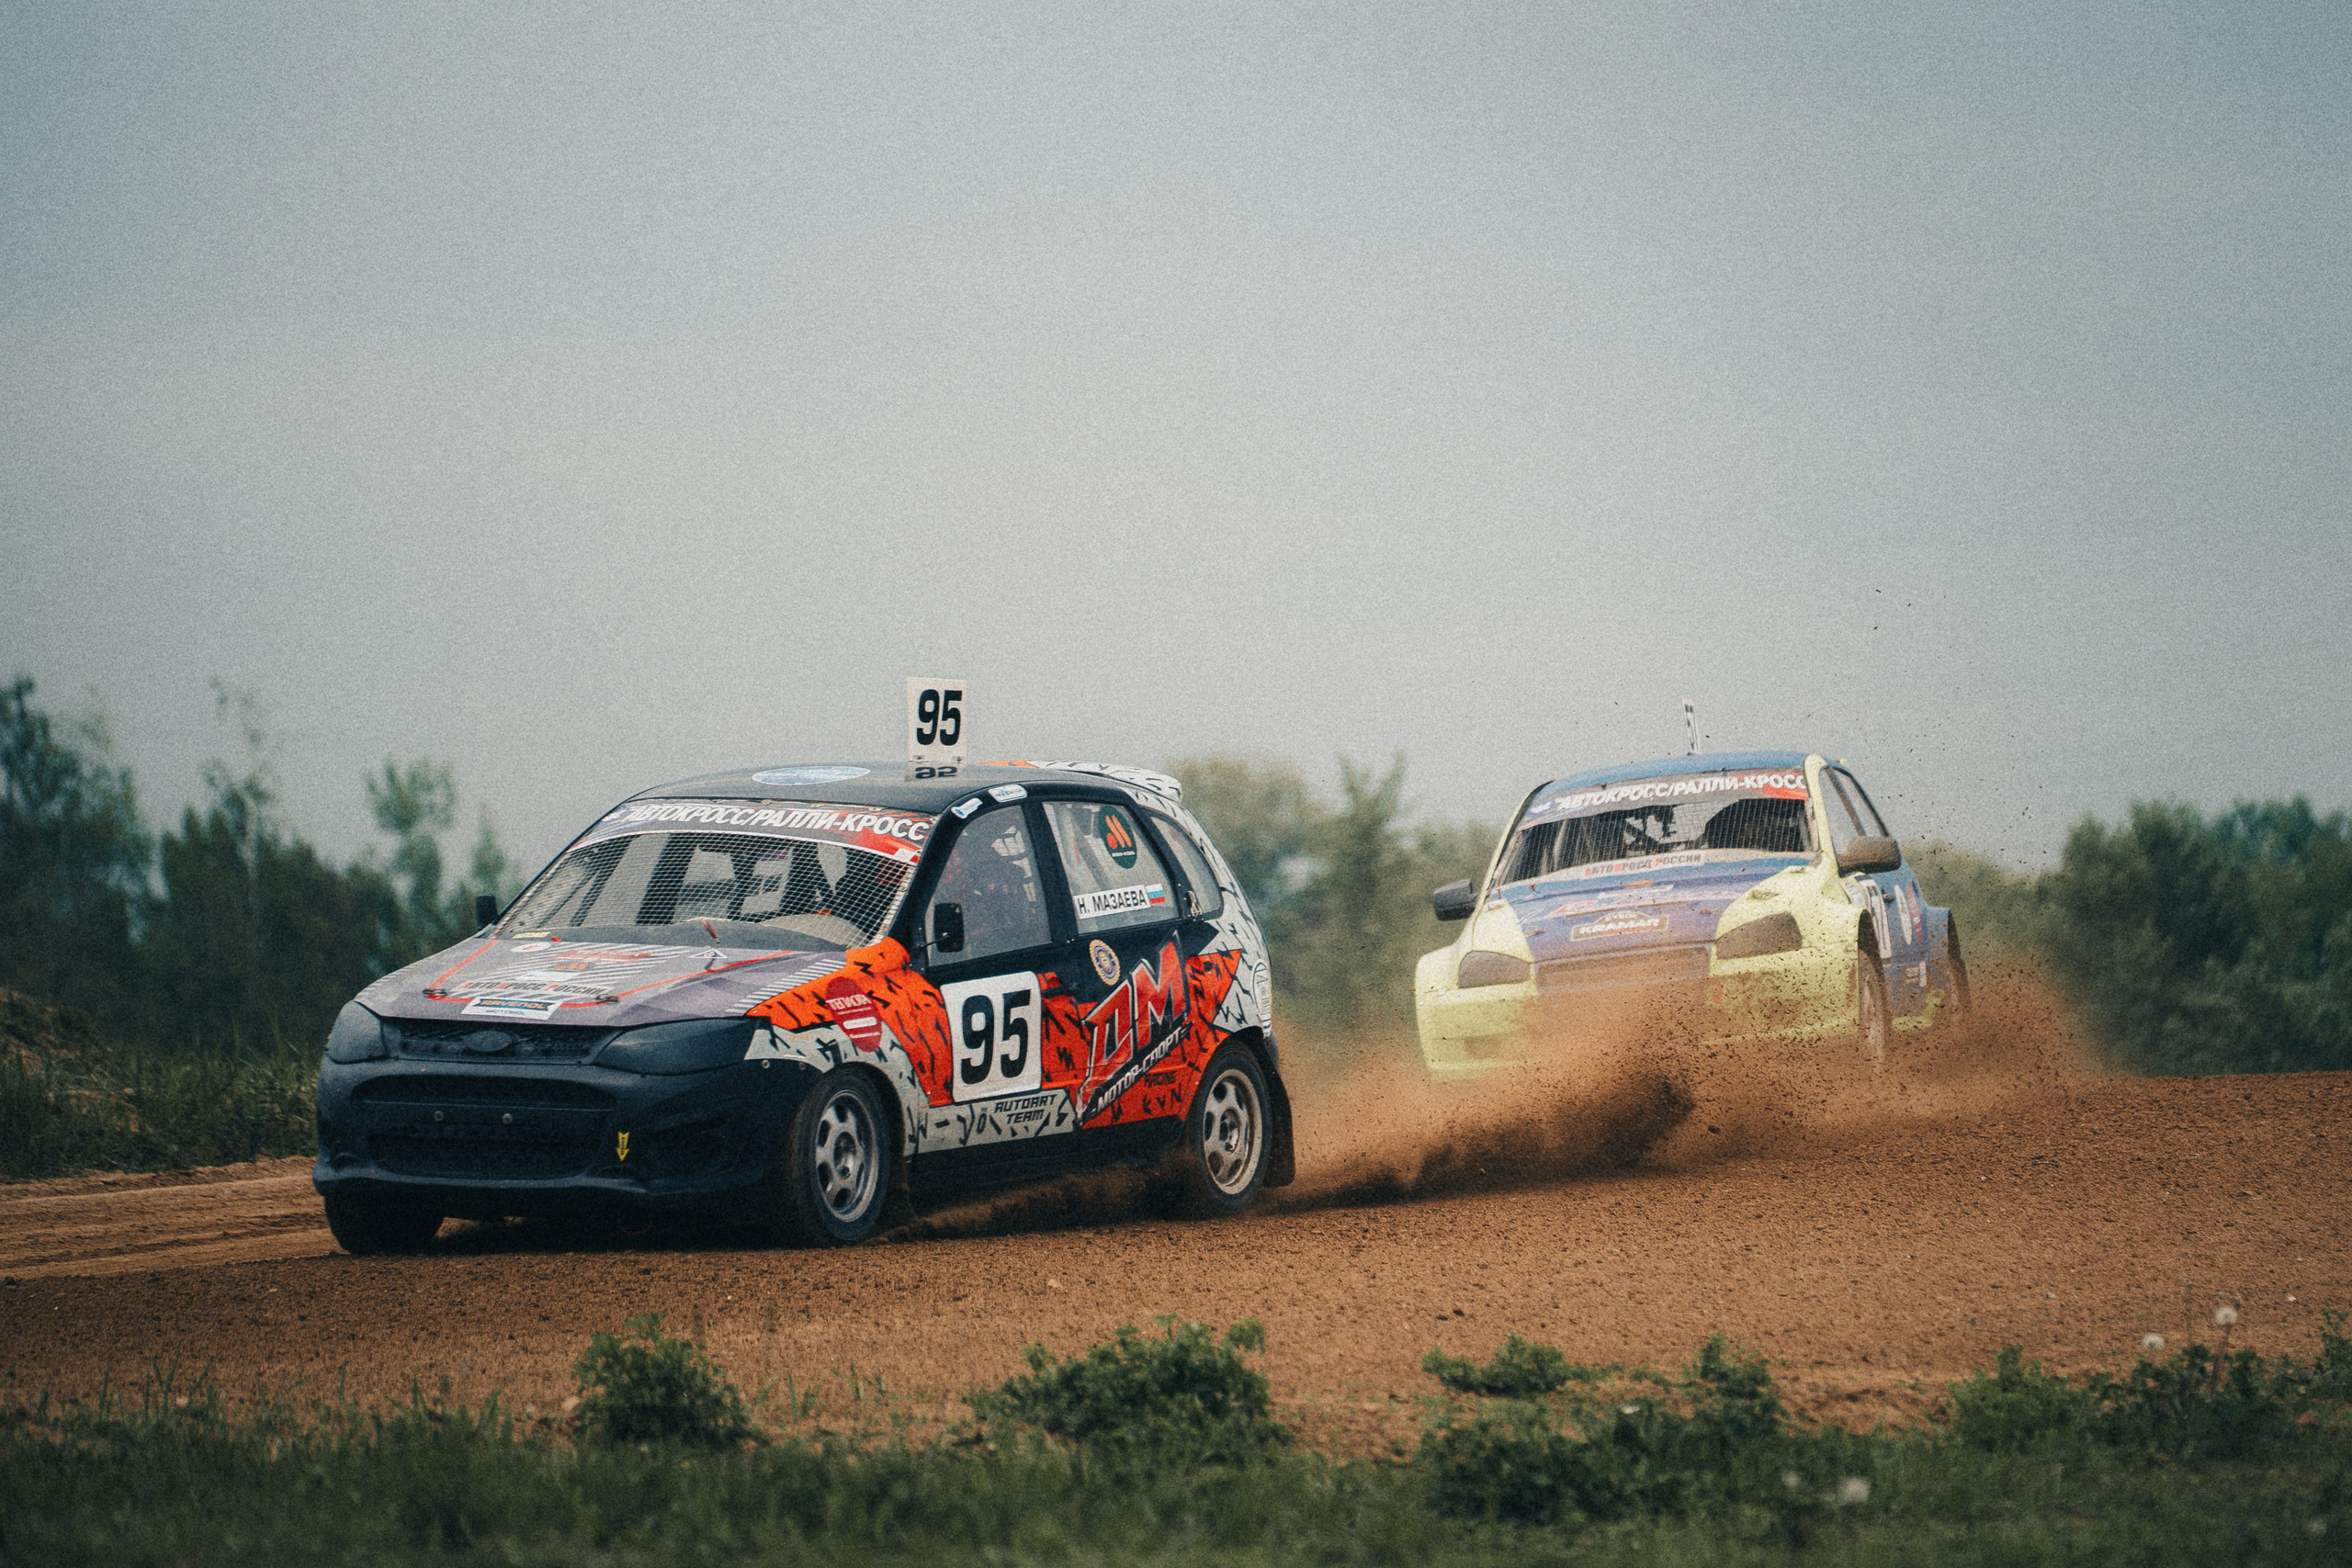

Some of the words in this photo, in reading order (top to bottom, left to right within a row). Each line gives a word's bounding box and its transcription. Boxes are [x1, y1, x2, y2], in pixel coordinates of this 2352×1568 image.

[917, 689, 963, 746] 95
[621, 805, 930, 840] АВТОКРОСС/РАЛЛИ-КРОСС
[1078, 897, 1090, 915] Н.
[1093, 889, 1148, 913] МАЗАЕВА
[481, 999, 546, 1010] RAVENOL
[960, 988, 1032, 1085] 95
[994, 1094, 1057, 1113] AUTOART
[1007, 1109, 1045, 1124] TEAM
